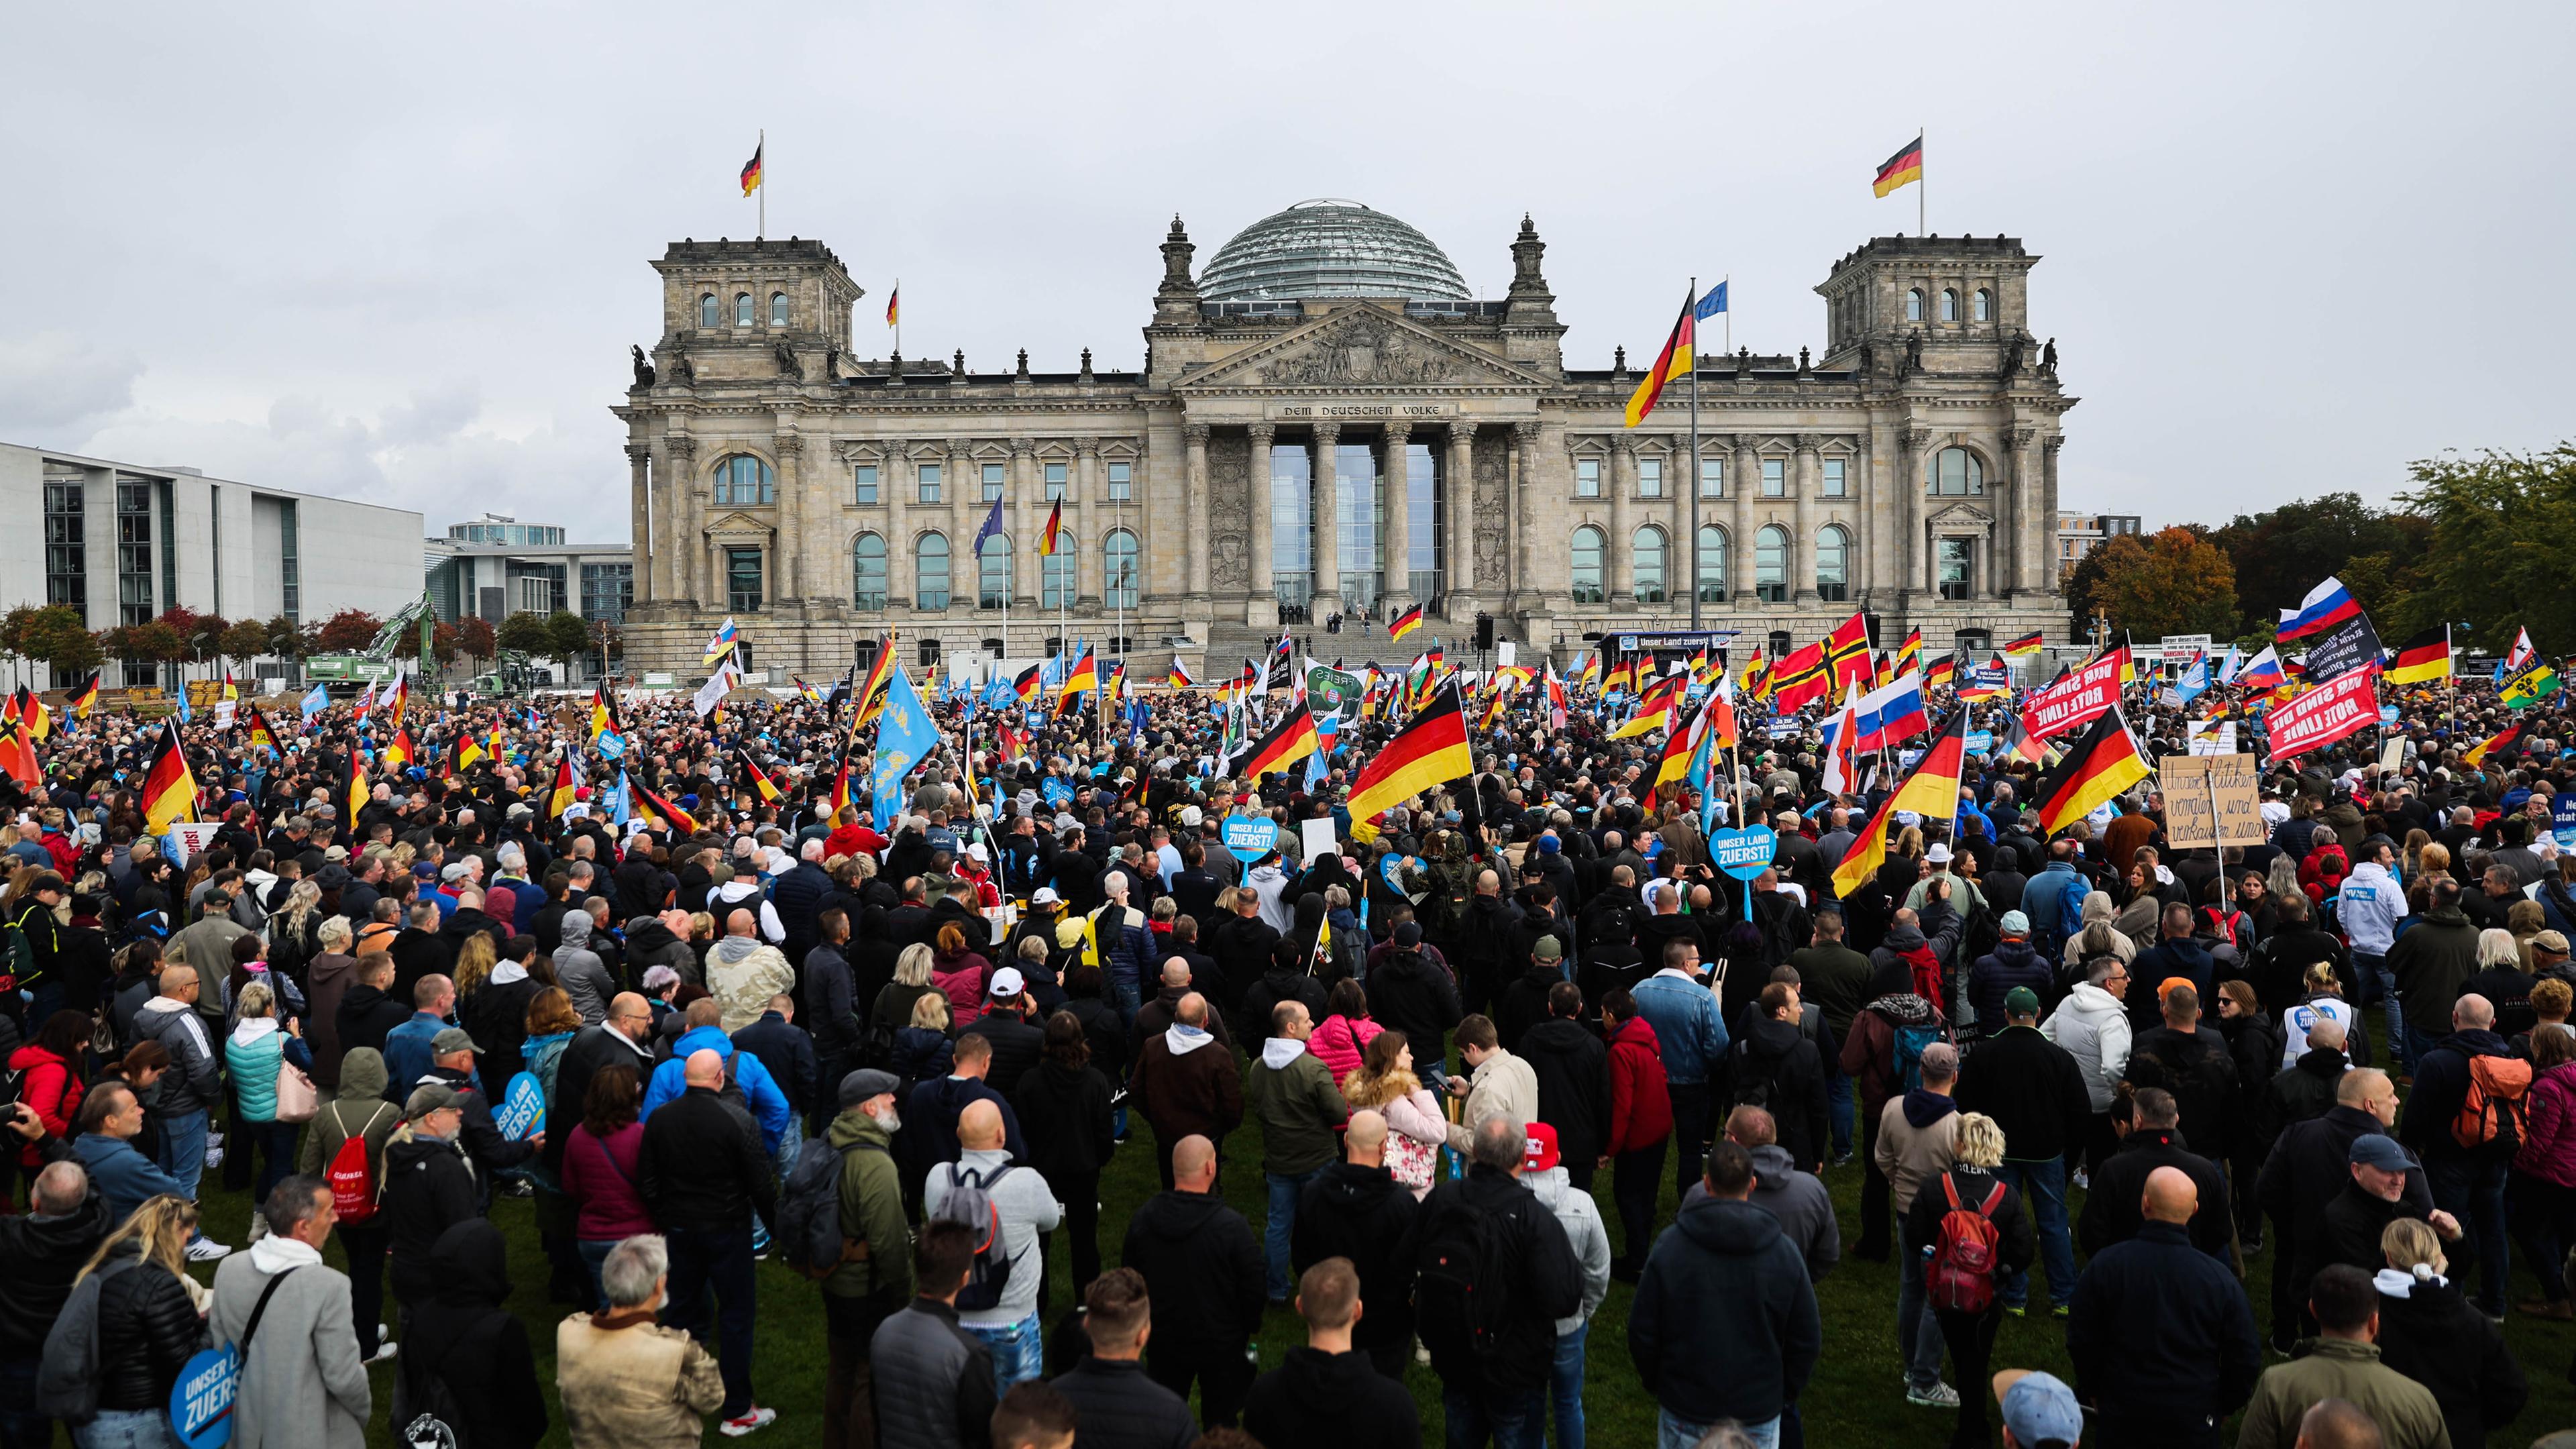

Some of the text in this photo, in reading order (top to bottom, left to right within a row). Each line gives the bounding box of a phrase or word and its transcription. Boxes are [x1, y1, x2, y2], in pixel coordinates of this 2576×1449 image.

[1284, 407, 1439, 415] DEM DEUTSCHEN VOLKE
[1641, 638, 1662, 646] Unser
[1664, 637, 1682, 645] Land
[1770, 722, 1799, 731] Kernkraft!
[1965, 739, 1990, 749] ZUERST!
[2226, 794, 2253, 814] und
[1229, 823, 1273, 834] UNSER LAND
[2235, 821, 2262, 839] uns
[1227, 833, 1271, 847] ZUERST!
[1718, 834, 1770, 849] UNSER LAND
[1719, 845, 1770, 865] ZUERST!
[511, 1079, 531, 1109] LAND
[503, 1089, 541, 1142] UERST!
[185, 1358, 227, 1401] UNSER
[184, 1376, 241, 1433] ZUERS
